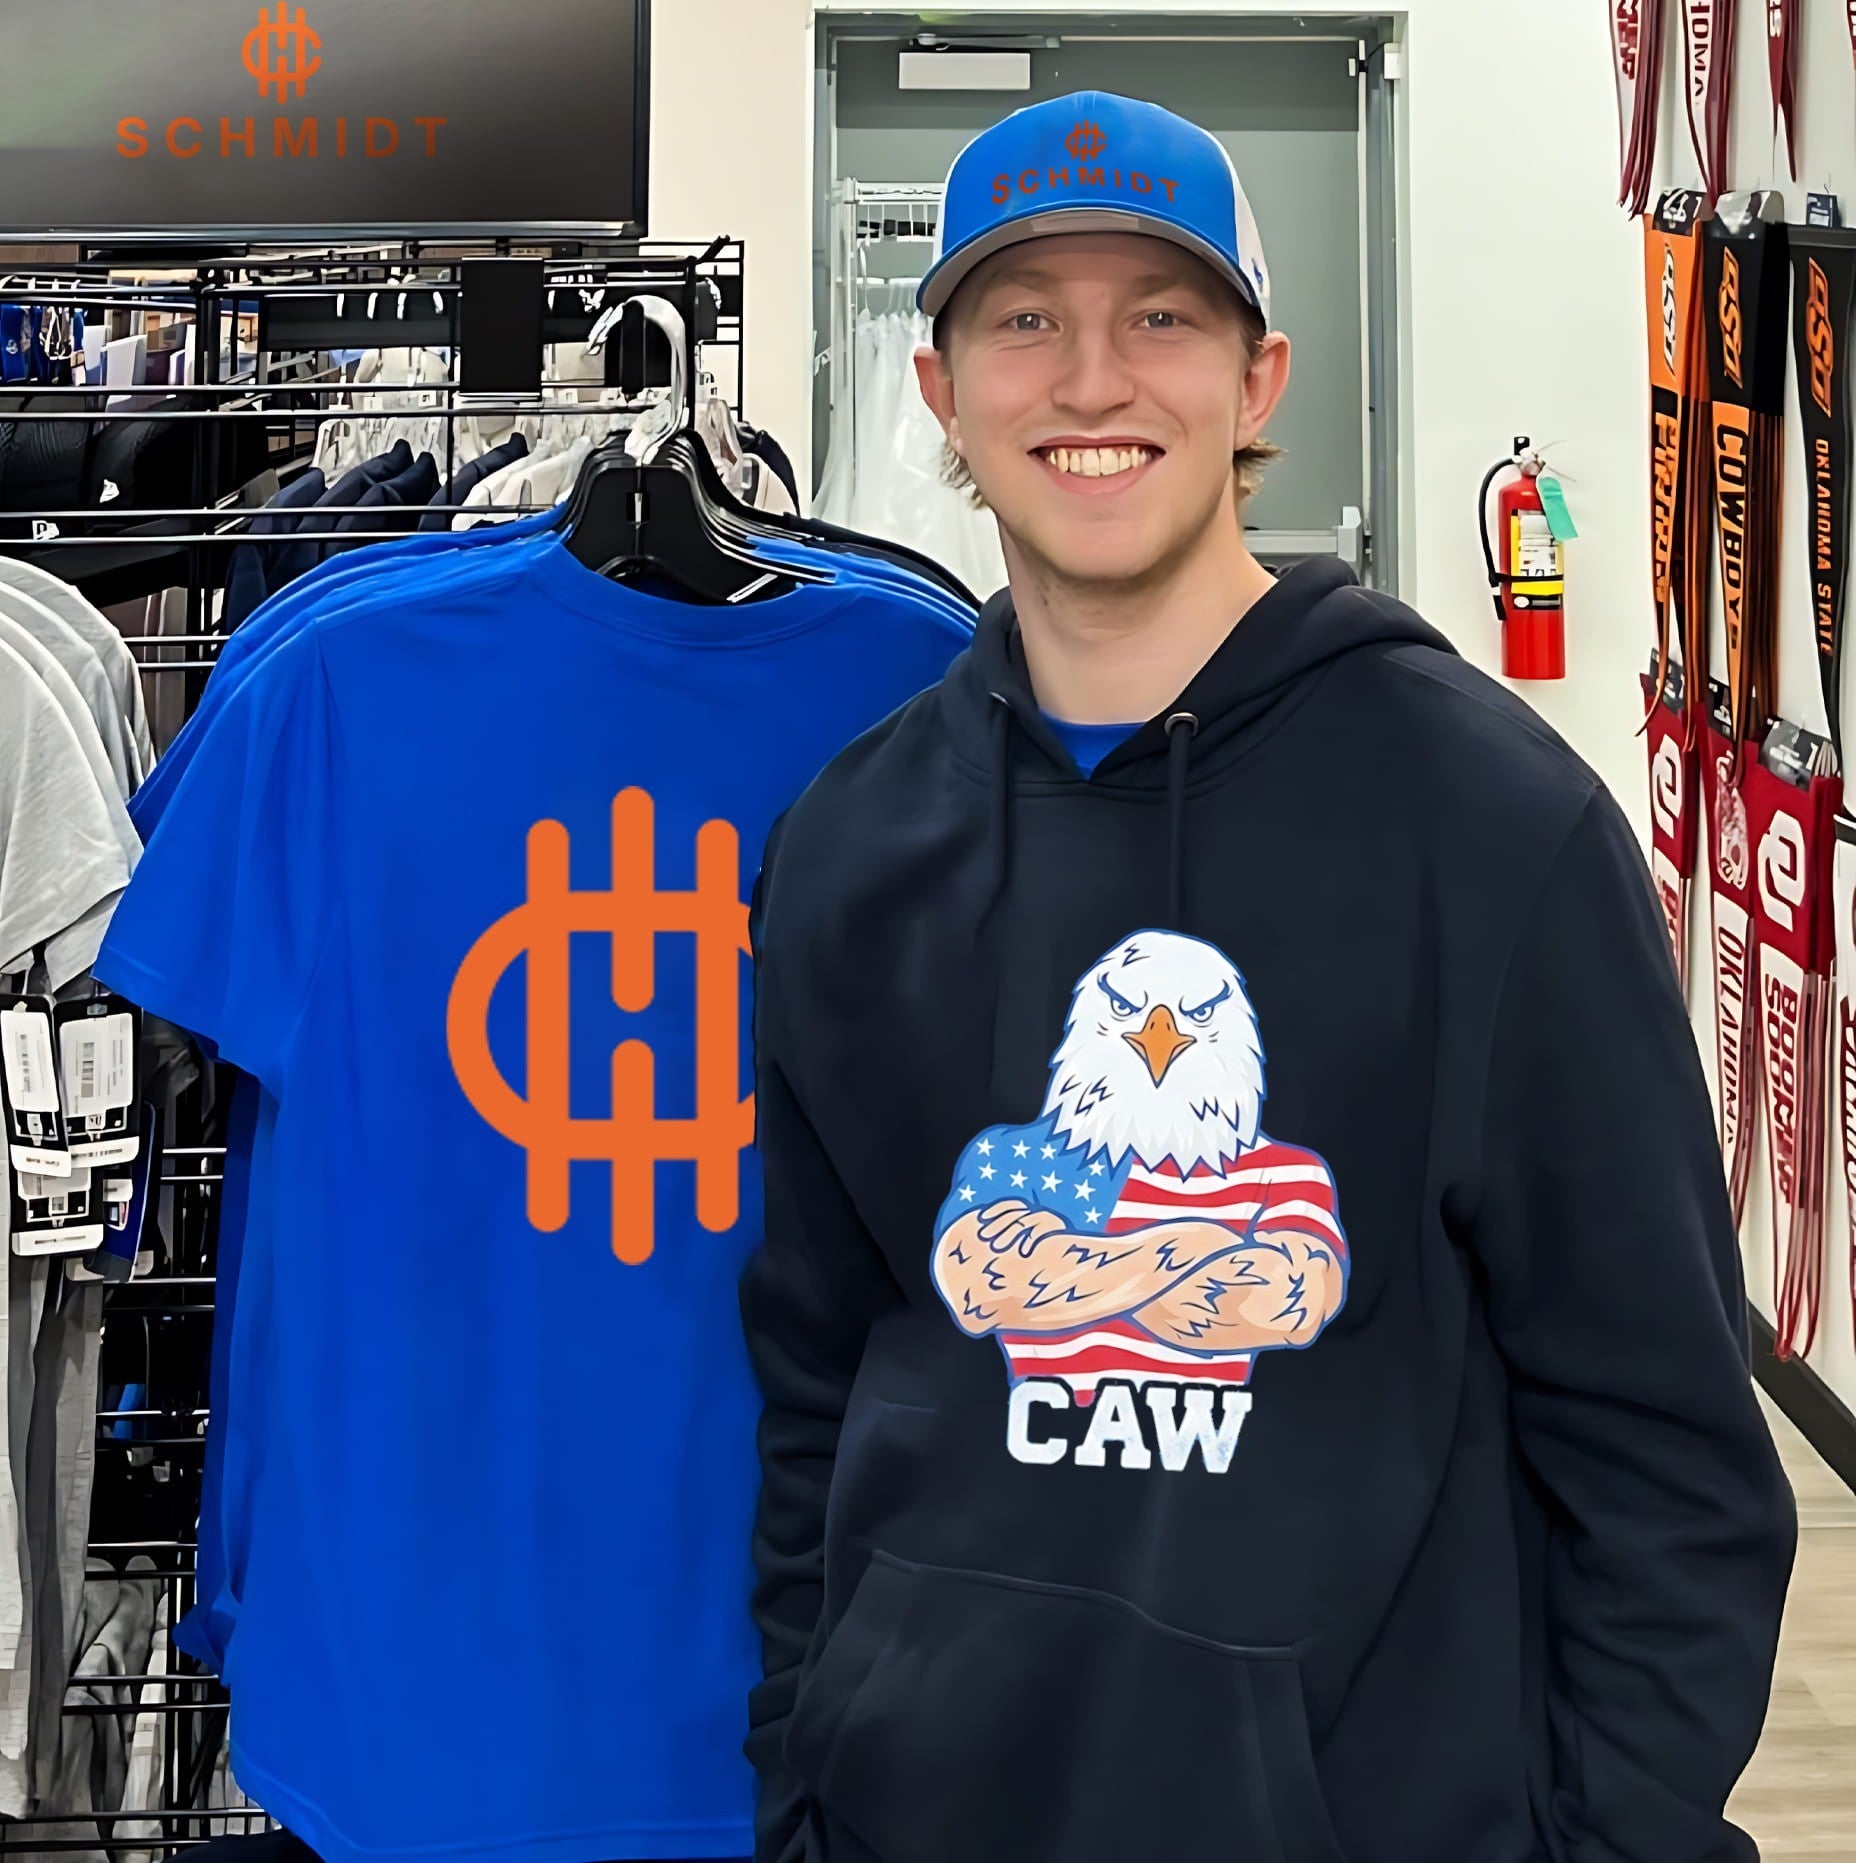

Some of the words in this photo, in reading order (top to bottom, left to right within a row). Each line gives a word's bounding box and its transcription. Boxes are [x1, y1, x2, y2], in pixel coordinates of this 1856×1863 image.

[115, 116, 447, 159] SCHMIDT
[991, 166, 1180, 205] SCHMIDT
[1006, 1381, 1253, 1474] CAW
